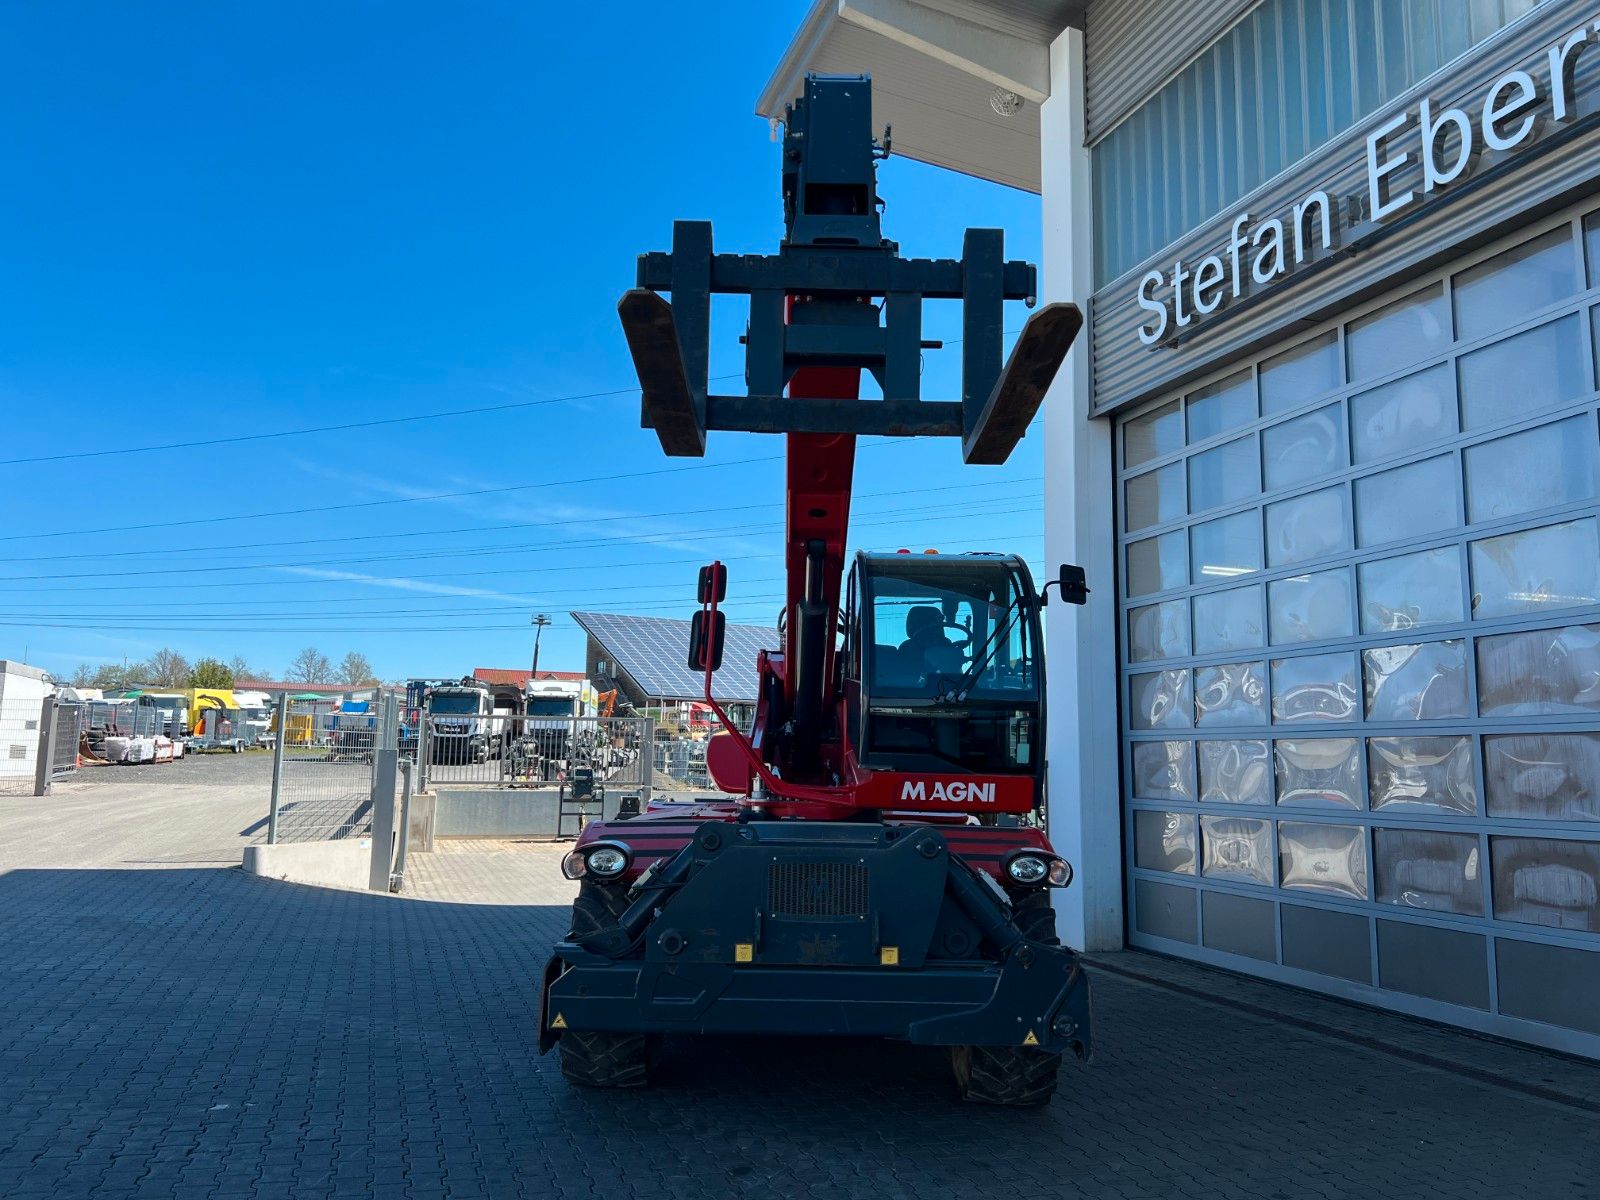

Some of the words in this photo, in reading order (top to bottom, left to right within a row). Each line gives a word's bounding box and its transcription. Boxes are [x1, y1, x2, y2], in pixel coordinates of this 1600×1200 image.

[1137, 190, 1332, 345] Stefan
[1366, 20, 1600, 223] Eber
[901, 781, 996, 802] MAGNI
